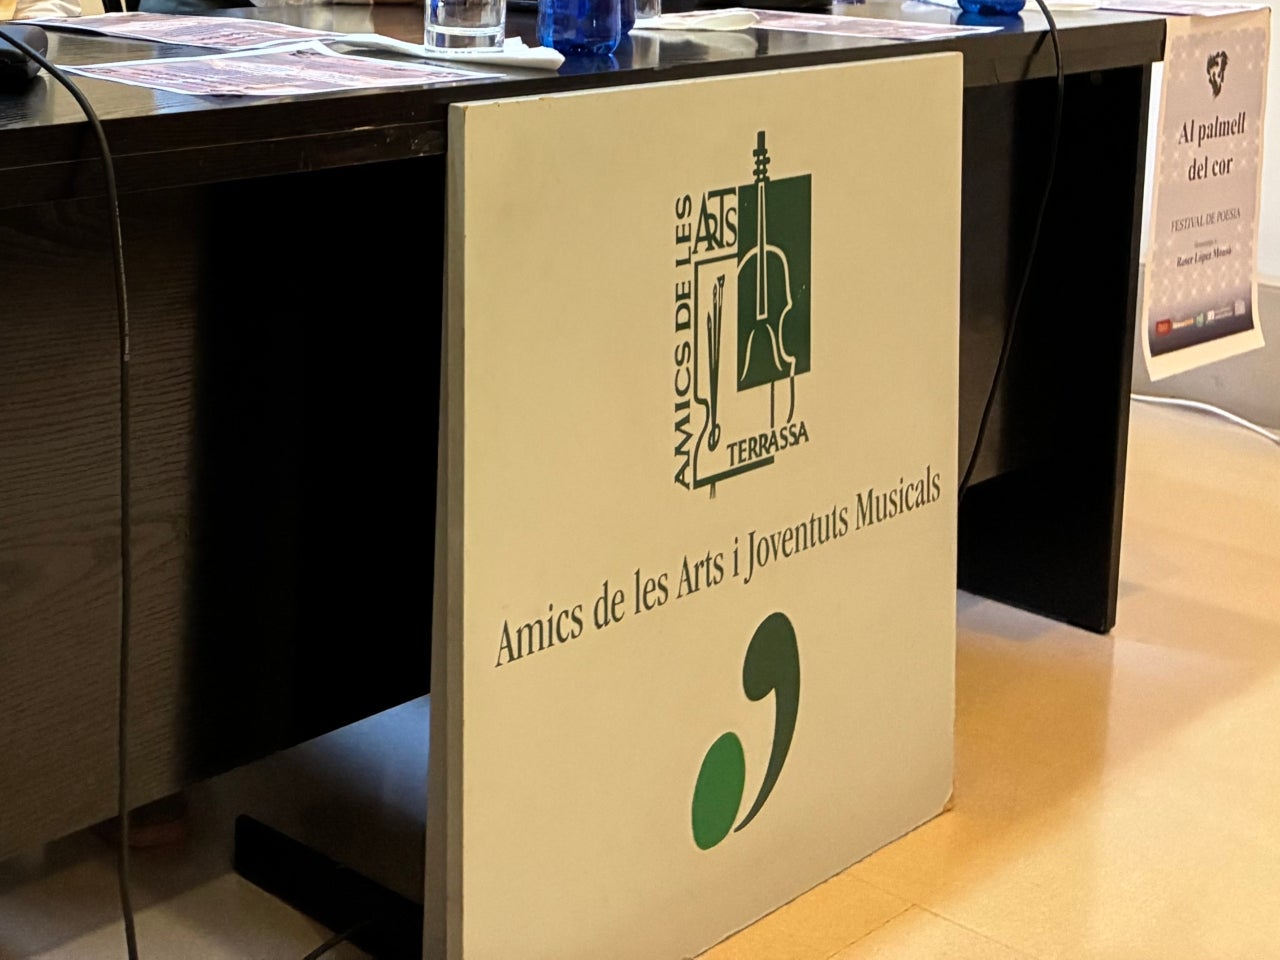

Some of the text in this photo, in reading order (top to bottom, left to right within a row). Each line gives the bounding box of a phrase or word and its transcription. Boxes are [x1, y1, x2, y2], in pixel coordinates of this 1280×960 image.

[1178, 111, 1246, 148] Al palmell
[1188, 155, 1233, 181] del cor
[692, 187, 738, 255] ARTS
[1171, 207, 1241, 233] FESTIVAL DE POESIA
[674, 193, 692, 491] AMICS DE LES
[726, 420, 810, 468] TERRASSA
[494, 464, 941, 668] Amics de les Arts i Joventuts Musicals
